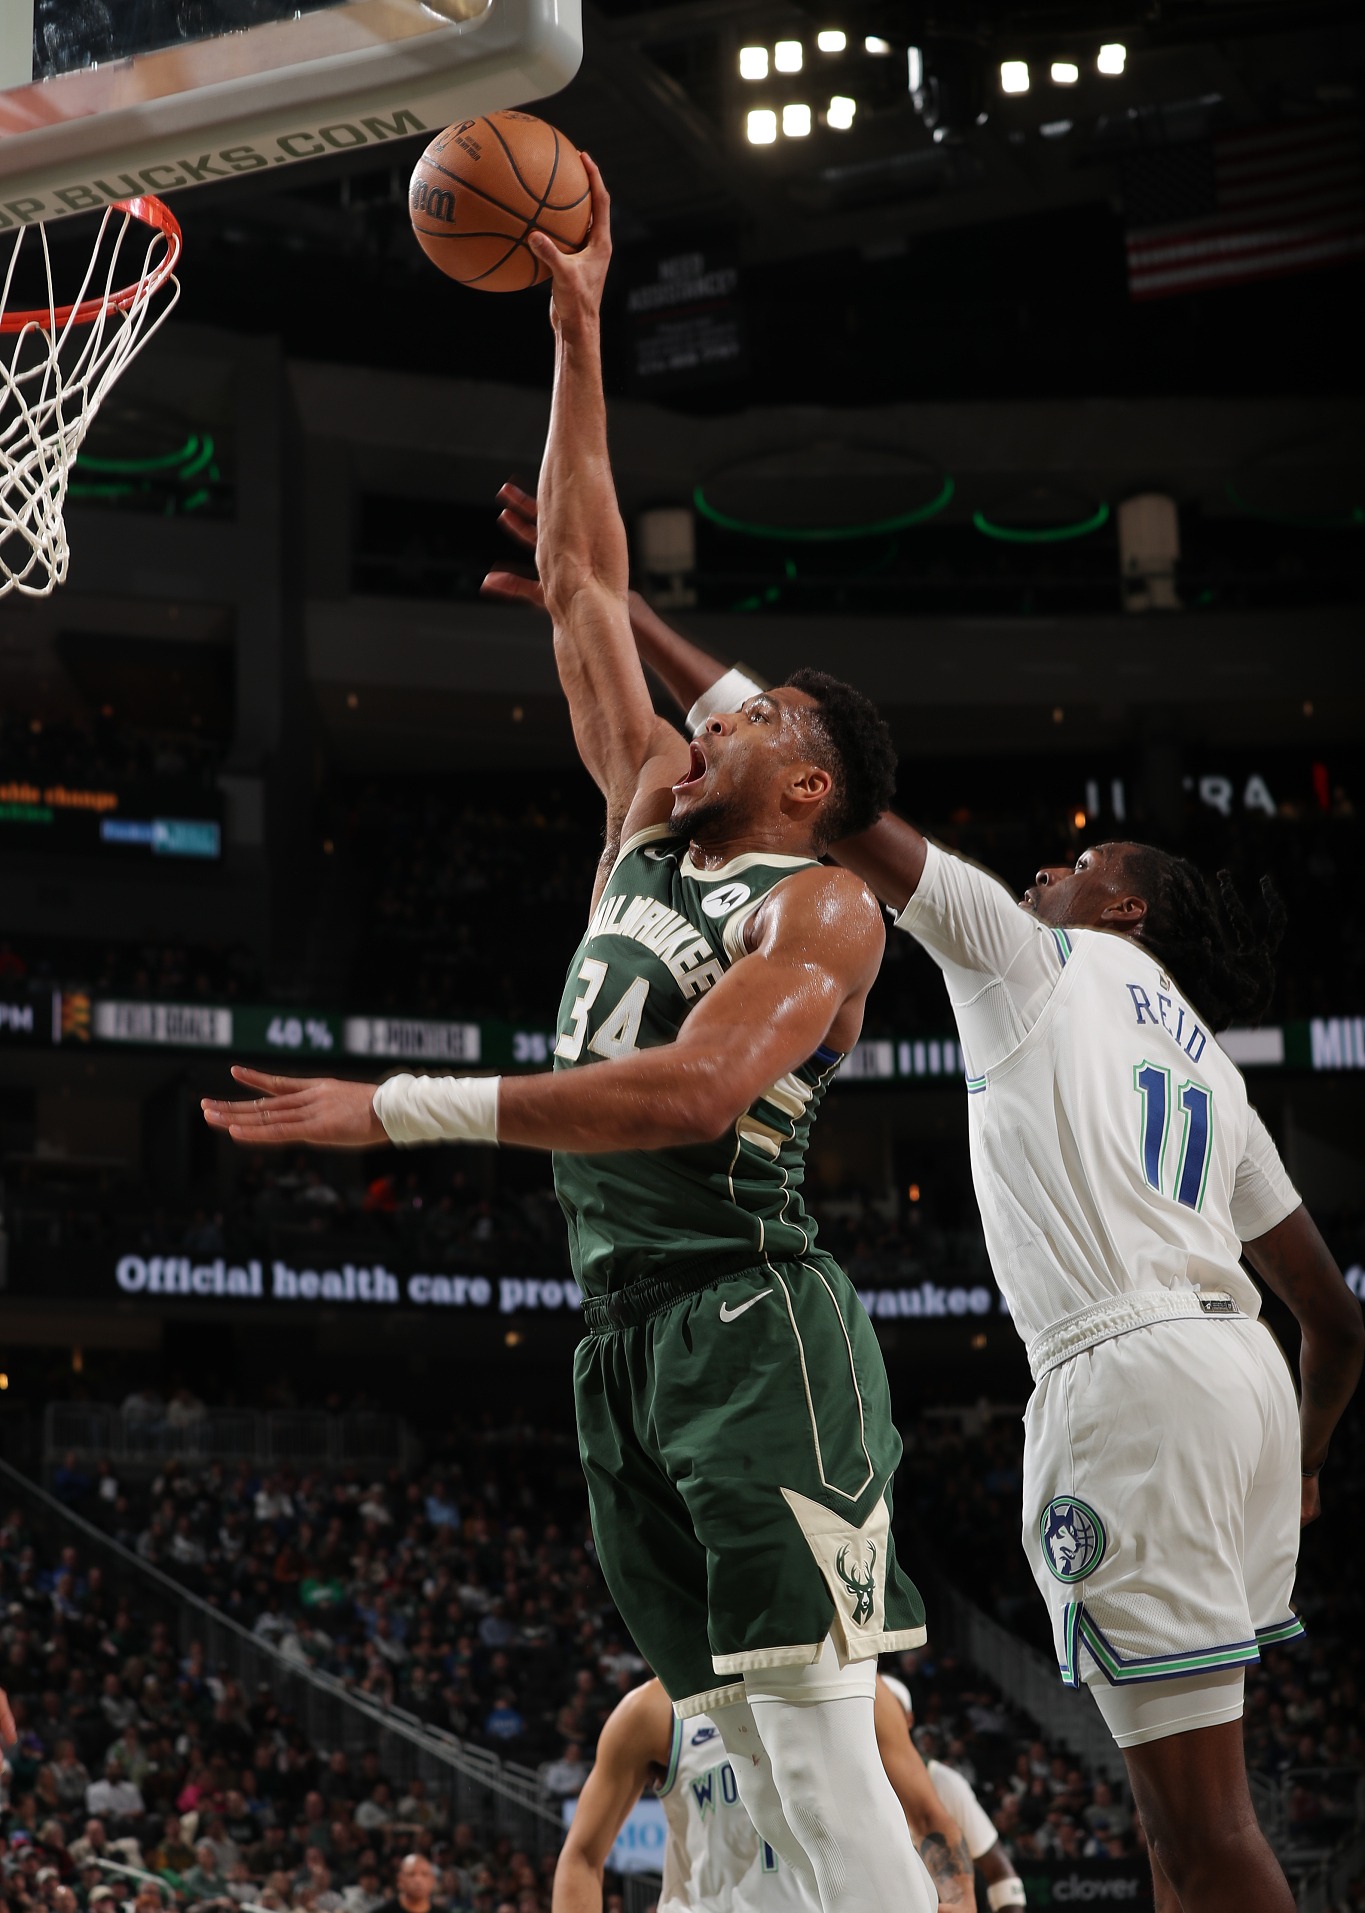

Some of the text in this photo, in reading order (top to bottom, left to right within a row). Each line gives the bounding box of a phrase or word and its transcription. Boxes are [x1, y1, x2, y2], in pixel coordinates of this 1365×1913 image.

[554, 956, 651, 1062] 34
[1126, 983, 1207, 1064] REID
[512, 1031, 556, 1064] 35
[1133, 1058, 1214, 1214] 11
[115, 1255, 263, 1296] Official
[272, 1263, 398, 1301] health
[408, 1273, 491, 1306] care
[1052, 1873, 1139, 1901] clover
